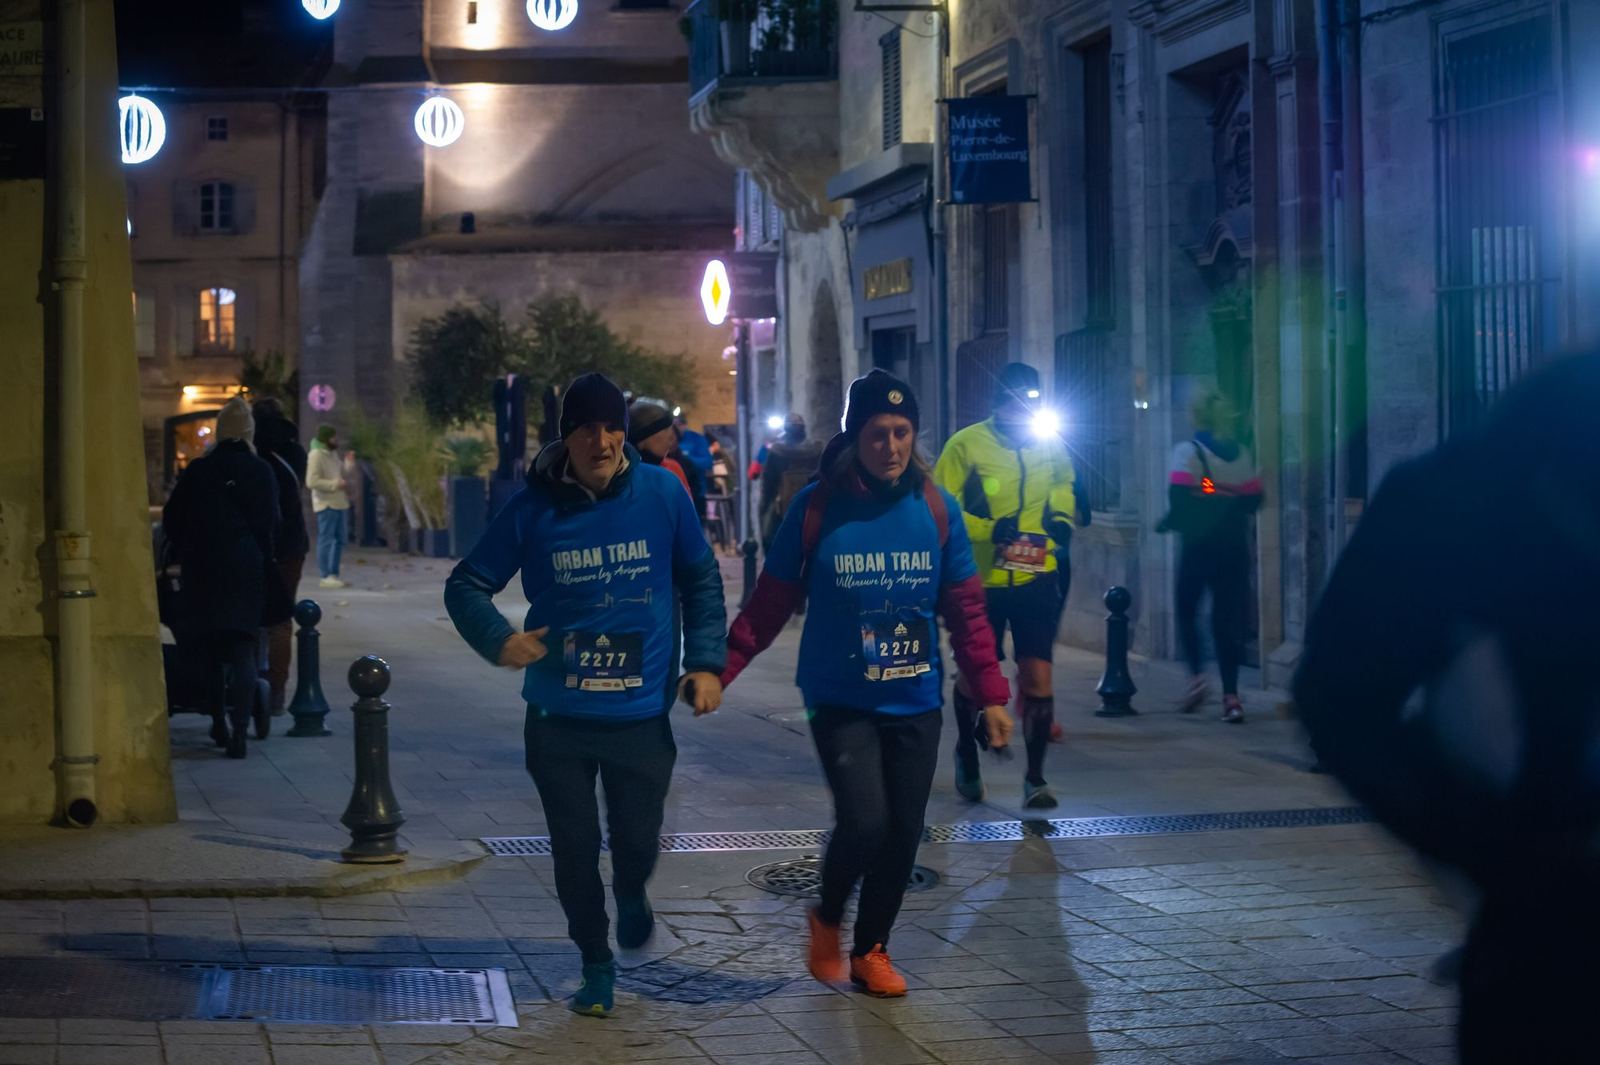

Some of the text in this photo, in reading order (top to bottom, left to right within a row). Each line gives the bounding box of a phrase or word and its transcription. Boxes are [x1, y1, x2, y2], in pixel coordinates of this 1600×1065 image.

[950, 113, 1002, 130] Musée
[951, 133, 1017, 147] Pierre-de-
[951, 149, 1028, 163] Luxembourg
[552, 539, 651, 571] URBAN TRAIL
[834, 551, 933, 574] URBAN TRAIL
[599, 567, 612, 584] lez
[836, 573, 930, 590] Villeneuve lez Avignon
[879, 639, 920, 657] 2278
[579, 650, 627, 667] 2277
